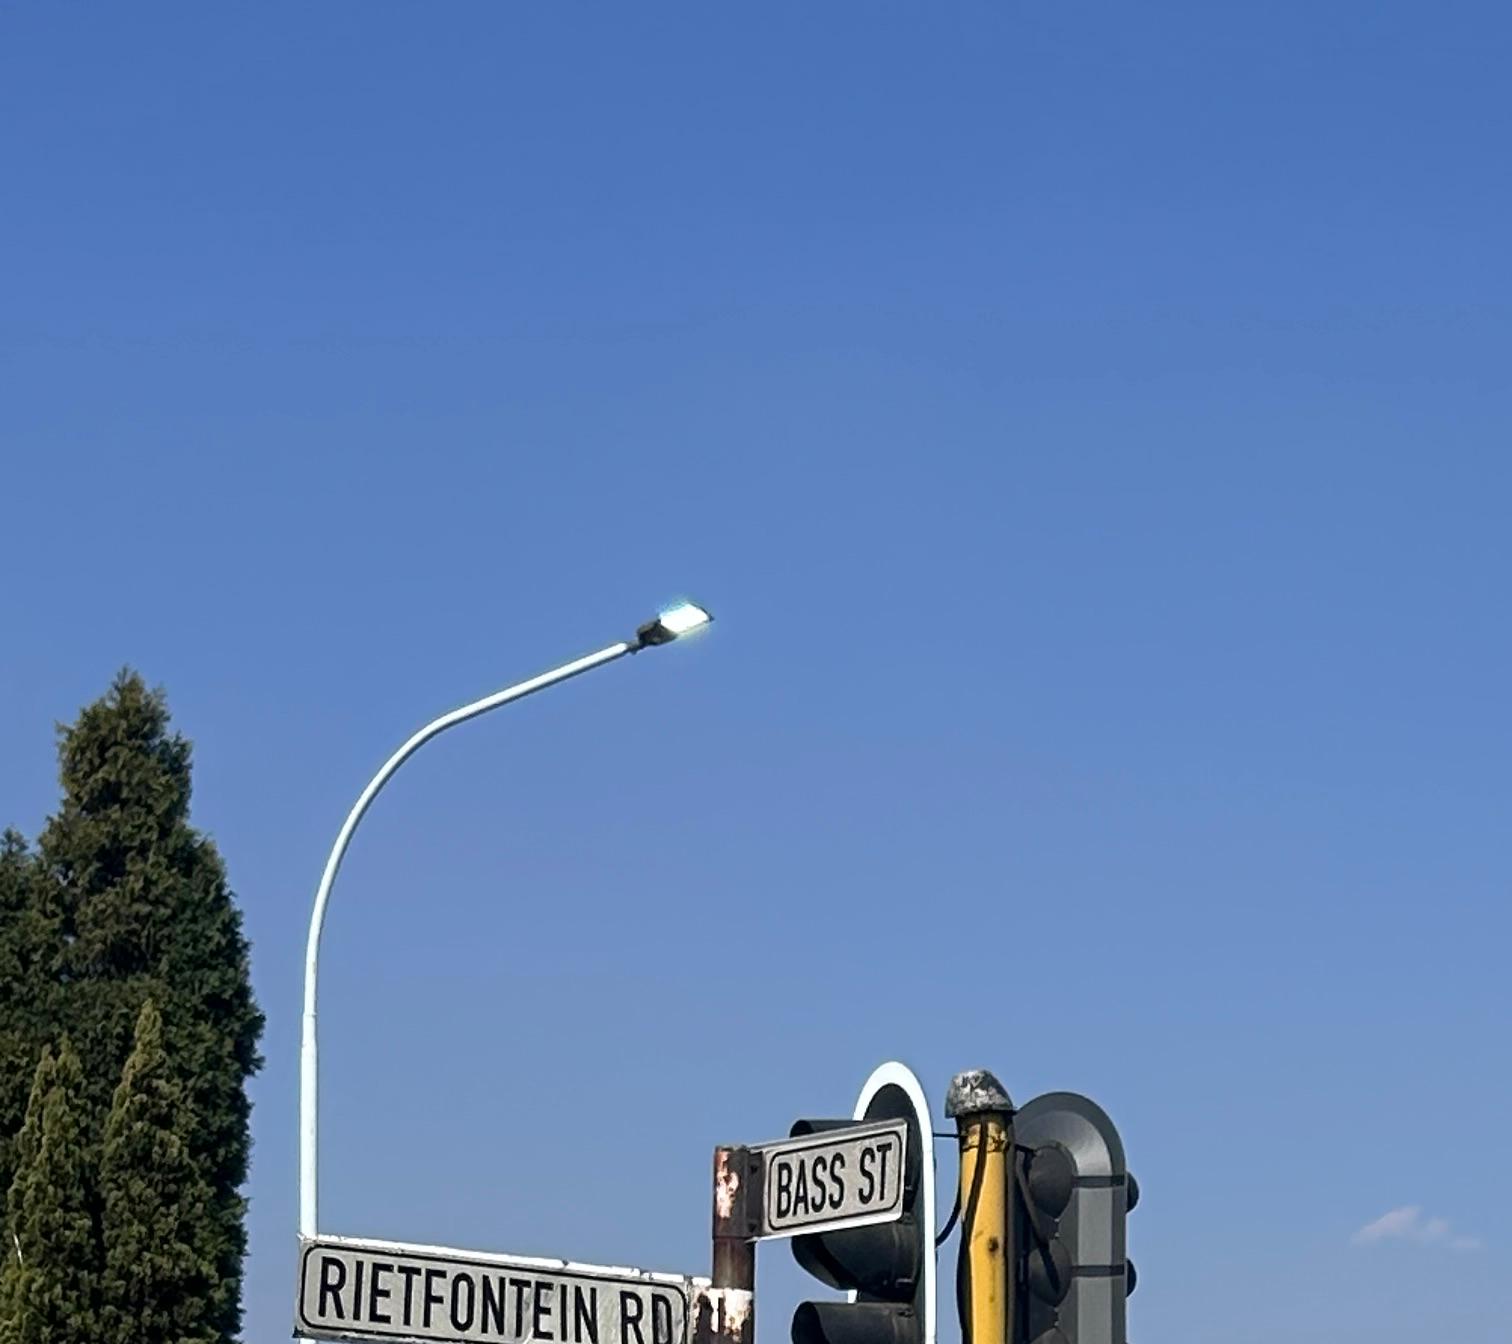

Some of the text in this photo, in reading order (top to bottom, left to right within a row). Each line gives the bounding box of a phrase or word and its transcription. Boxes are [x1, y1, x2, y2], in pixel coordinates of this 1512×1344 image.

[777, 1142, 892, 1219] BASS ST
[318, 1256, 599, 1344] RIETFONTEIN
